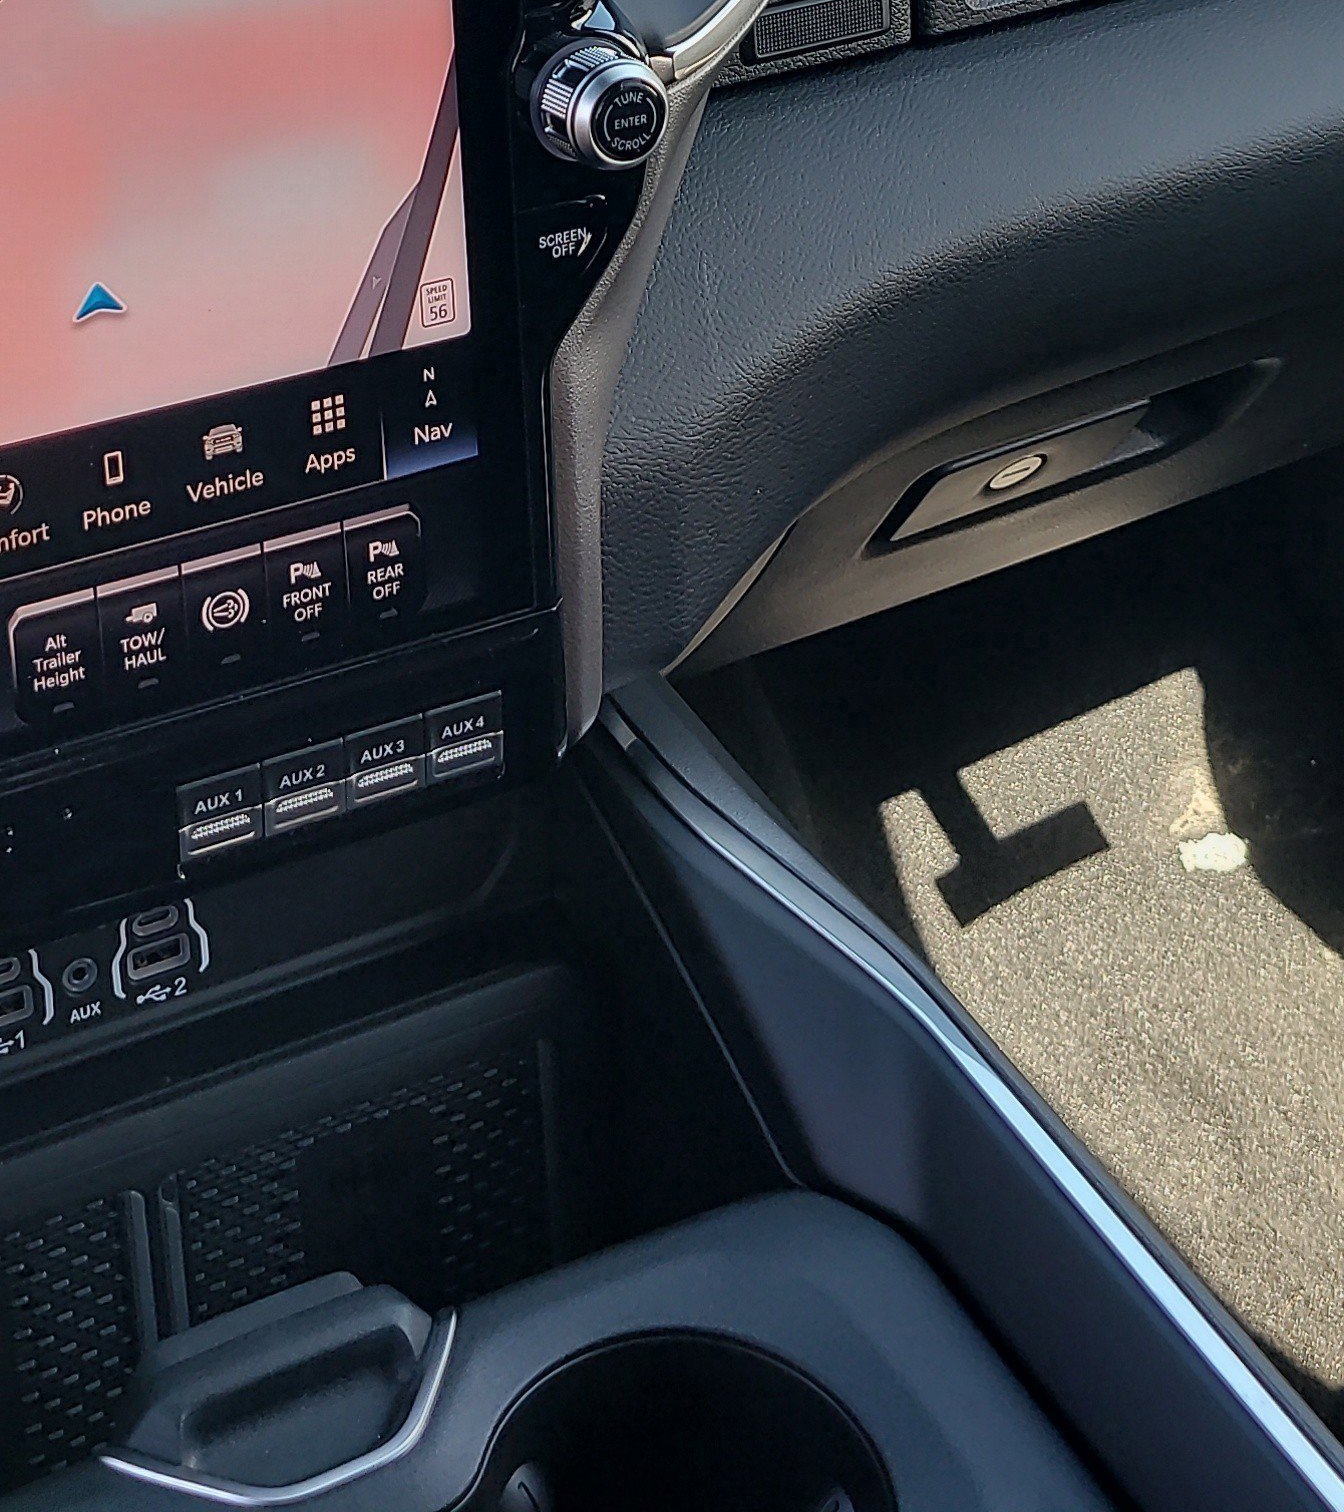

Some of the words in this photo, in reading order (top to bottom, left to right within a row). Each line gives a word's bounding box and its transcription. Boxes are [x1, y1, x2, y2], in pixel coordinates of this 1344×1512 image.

[613, 92, 644, 108] TUNE
[613, 113, 648, 129] ENTER
[611, 132, 652, 152] SCROLL
[538, 226, 588, 250] SCREEN
[551, 240, 577, 260] OFF
[425, 284, 448, 296] SPEED
[427, 293, 447, 304] LIMIT
[429, 304, 448, 321] 56
[423, 366, 435, 382] N
[414, 422, 453, 446] Nav
[305, 445, 356, 474] Apps
[186, 469, 264, 503] Vehicle
[83, 500, 151, 530] Phone
[367, 563, 404, 585] REAR
[283, 582, 332, 608] FRONT
[372, 581, 401, 601] OFF
[294, 603, 323, 623] OFF
[44, 634, 67, 652] Alt
[120, 627, 166, 654] TOW/
[33, 649, 81, 673] Trailer
[124, 648, 166, 671] HAUL
[33, 666, 86, 692] Height
[441, 720, 475, 739] AUX
[475, 715, 485, 729] 4
[360, 744, 395, 764] AUX
[396, 739, 405, 753] 3
[279, 768, 315, 789] AUX
[316, 764, 326, 777] 2
[194, 792, 230, 815] AUX
[235, 788, 243, 802] 1
[173, 977, 187, 997] 2
[69, 1000, 102, 1024] AUX
[15, 1031, 25, 1050] 1
